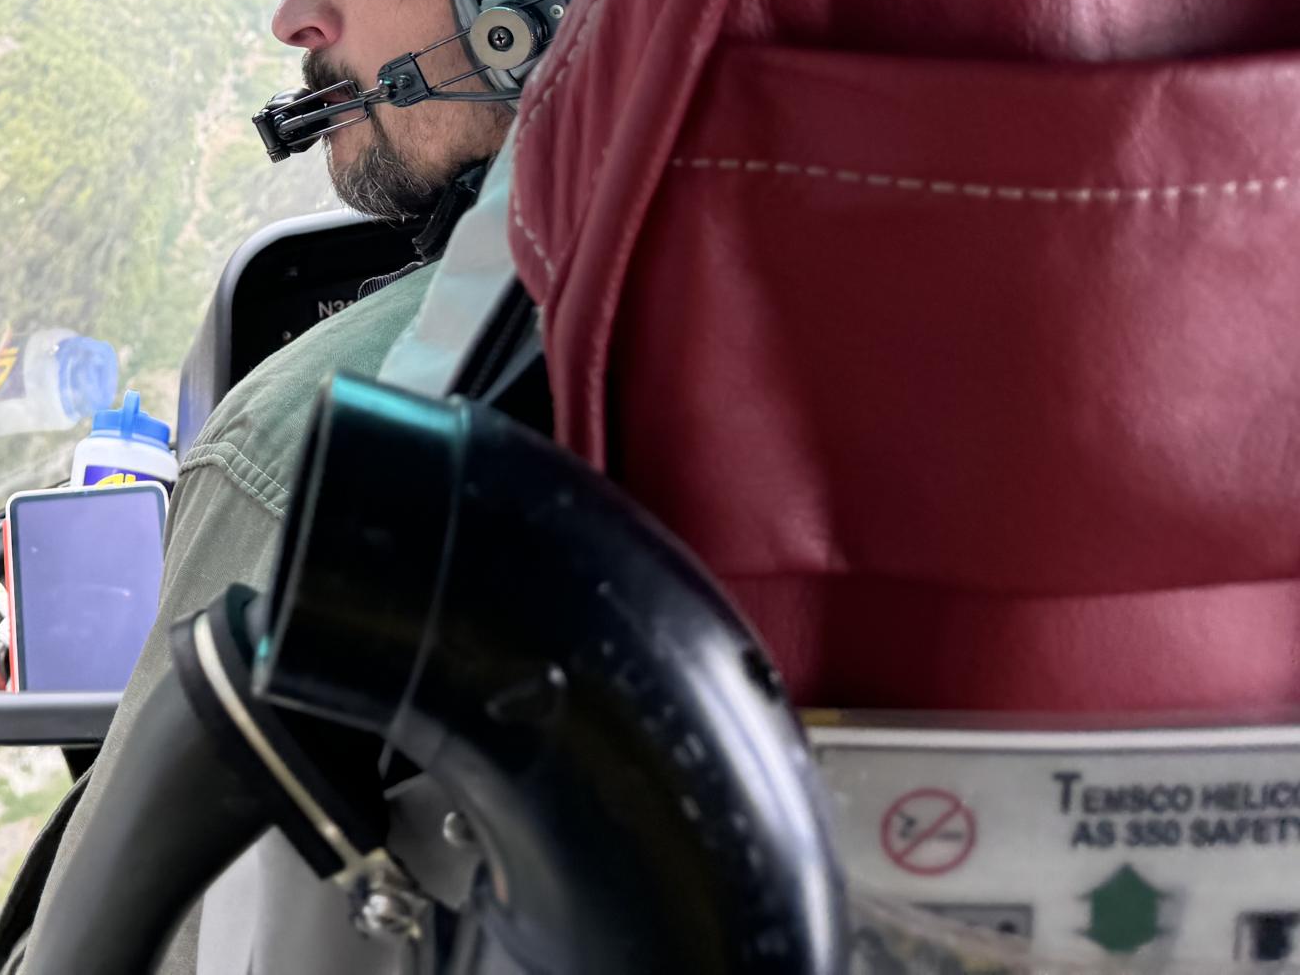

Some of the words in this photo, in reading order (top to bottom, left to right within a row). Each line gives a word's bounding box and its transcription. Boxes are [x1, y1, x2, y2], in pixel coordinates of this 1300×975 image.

[1052, 772, 1194, 814] TEMSCO
[1070, 820, 1117, 849] AS
[1124, 818, 1181, 847] 350
